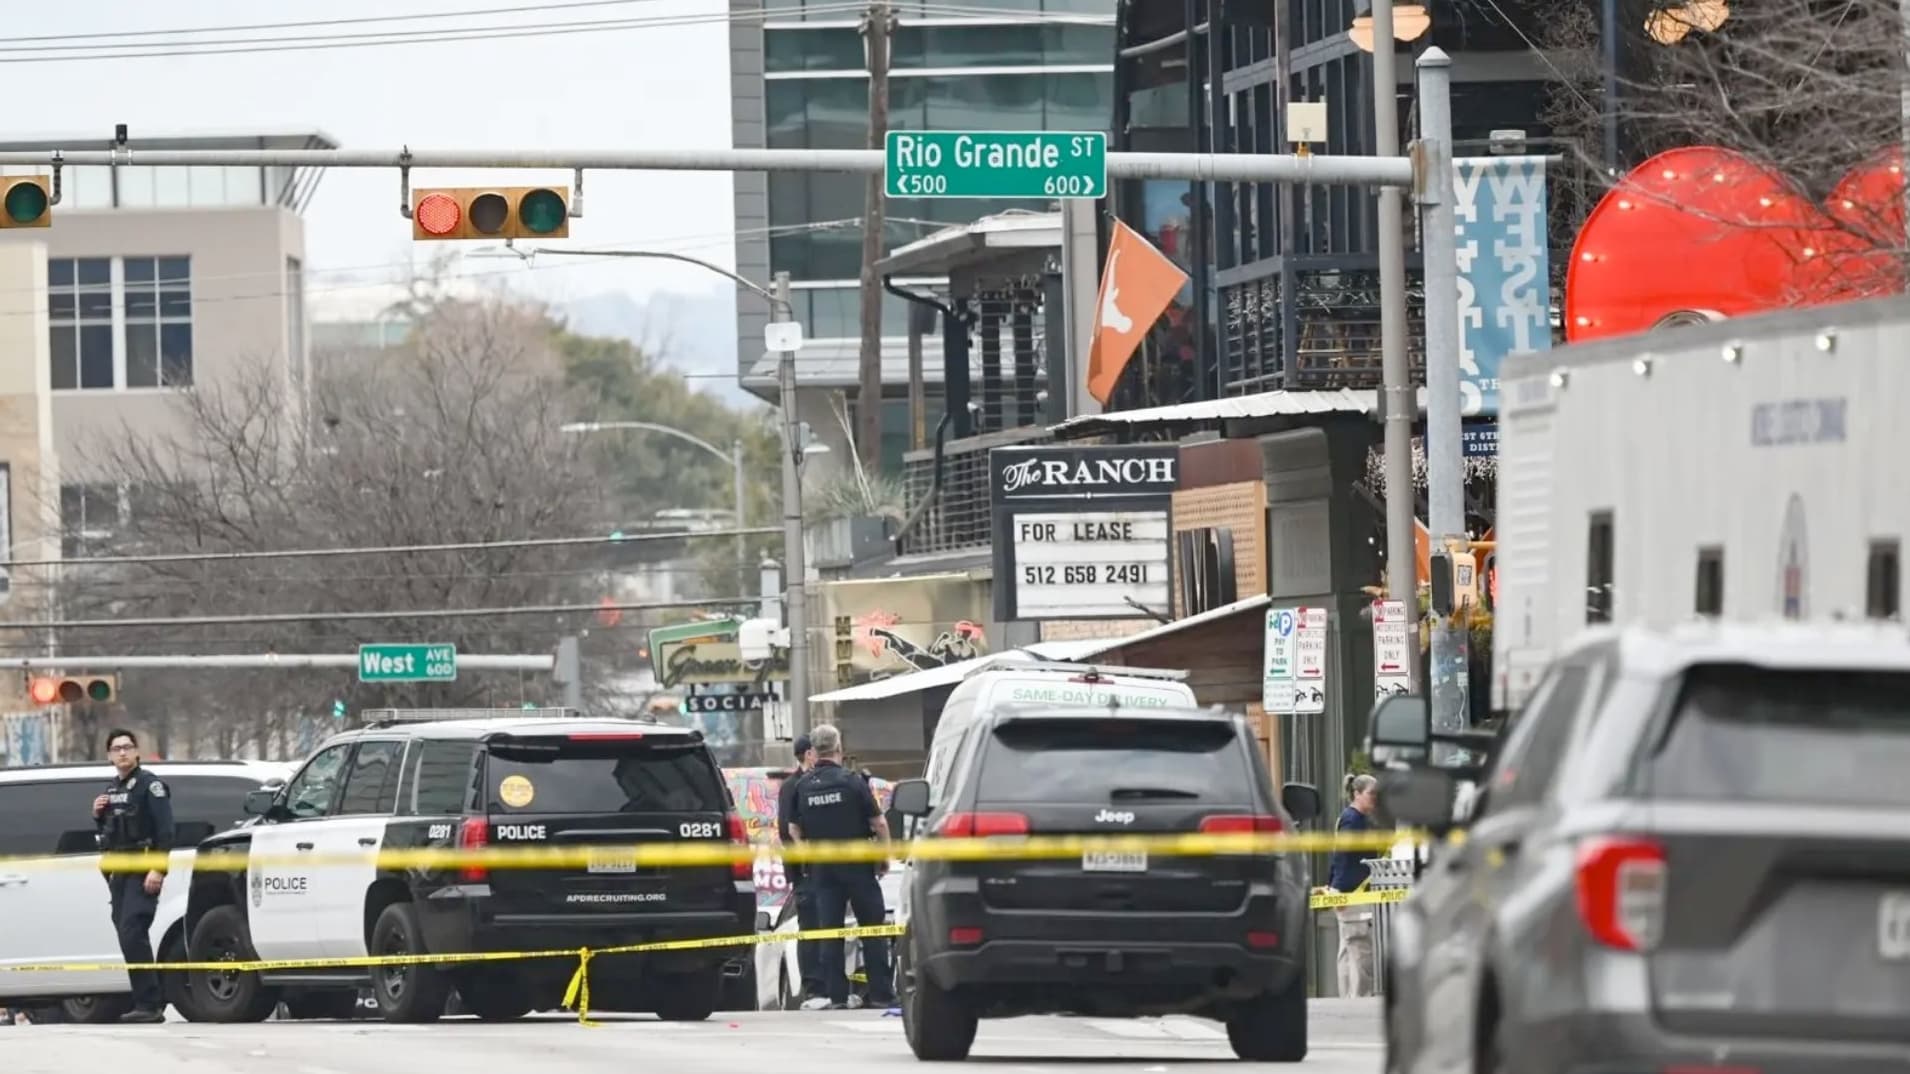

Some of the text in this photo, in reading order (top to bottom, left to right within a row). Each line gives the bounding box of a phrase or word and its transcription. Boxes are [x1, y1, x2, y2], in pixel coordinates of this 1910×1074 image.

[897, 136, 1095, 168] Rio Grande ST
[911, 175, 1080, 194] 500 600
[1002, 458, 1176, 491] The RANCH
[1021, 523, 1133, 542] FOR LEASE
[1025, 565, 1147, 584] 512 658 2491
[363, 648, 451, 674] West AVE
[426, 663, 452, 676] 600
[1012, 688, 1168, 707] SAME-DAY DLIVERY
[807, 792, 842, 806] POLICE
[1095, 809, 1136, 824] Jeep
[429, 824, 452, 839] 0281
[498, 825, 547, 839] POLICE
[680, 823, 721, 837] 0281
[265, 877, 307, 890] POLICE
[566, 893, 666, 902] APDRECRUITING.ORG
